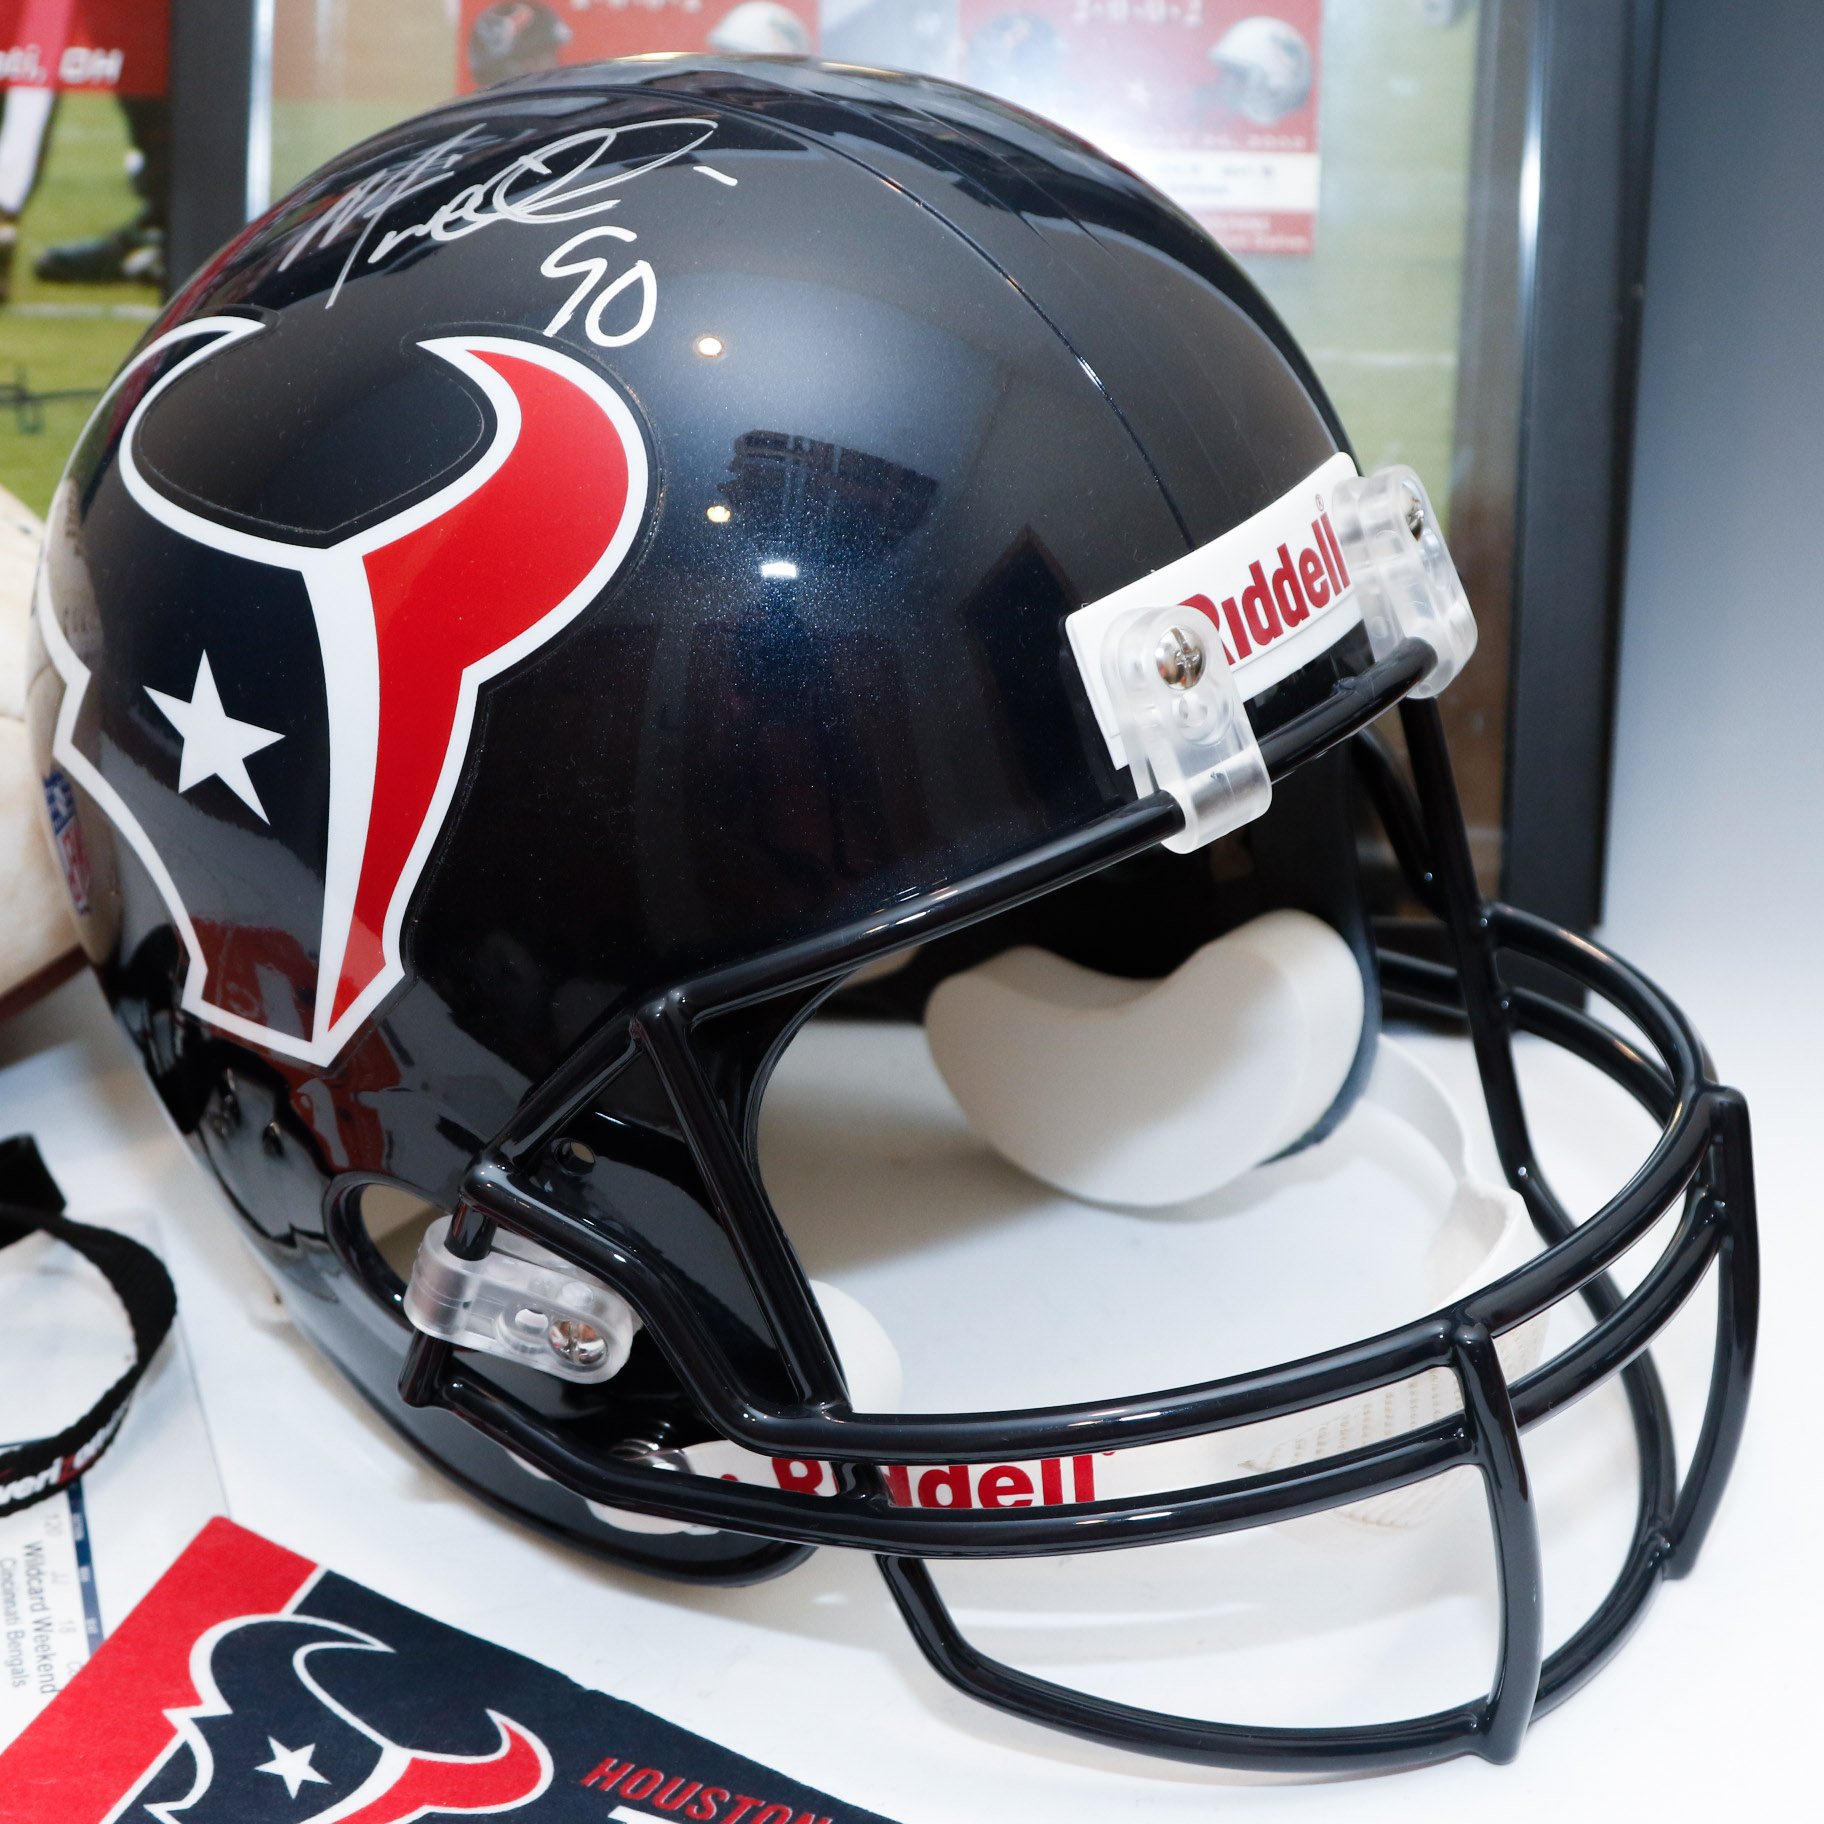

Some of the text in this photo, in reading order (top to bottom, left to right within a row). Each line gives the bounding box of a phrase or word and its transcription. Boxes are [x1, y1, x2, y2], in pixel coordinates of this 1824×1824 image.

[772, 1455, 1095, 1508] Rdell
[23, 1540, 61, 1695] Wildcard Weekend
[6, 1631, 29, 1688] Bengals
